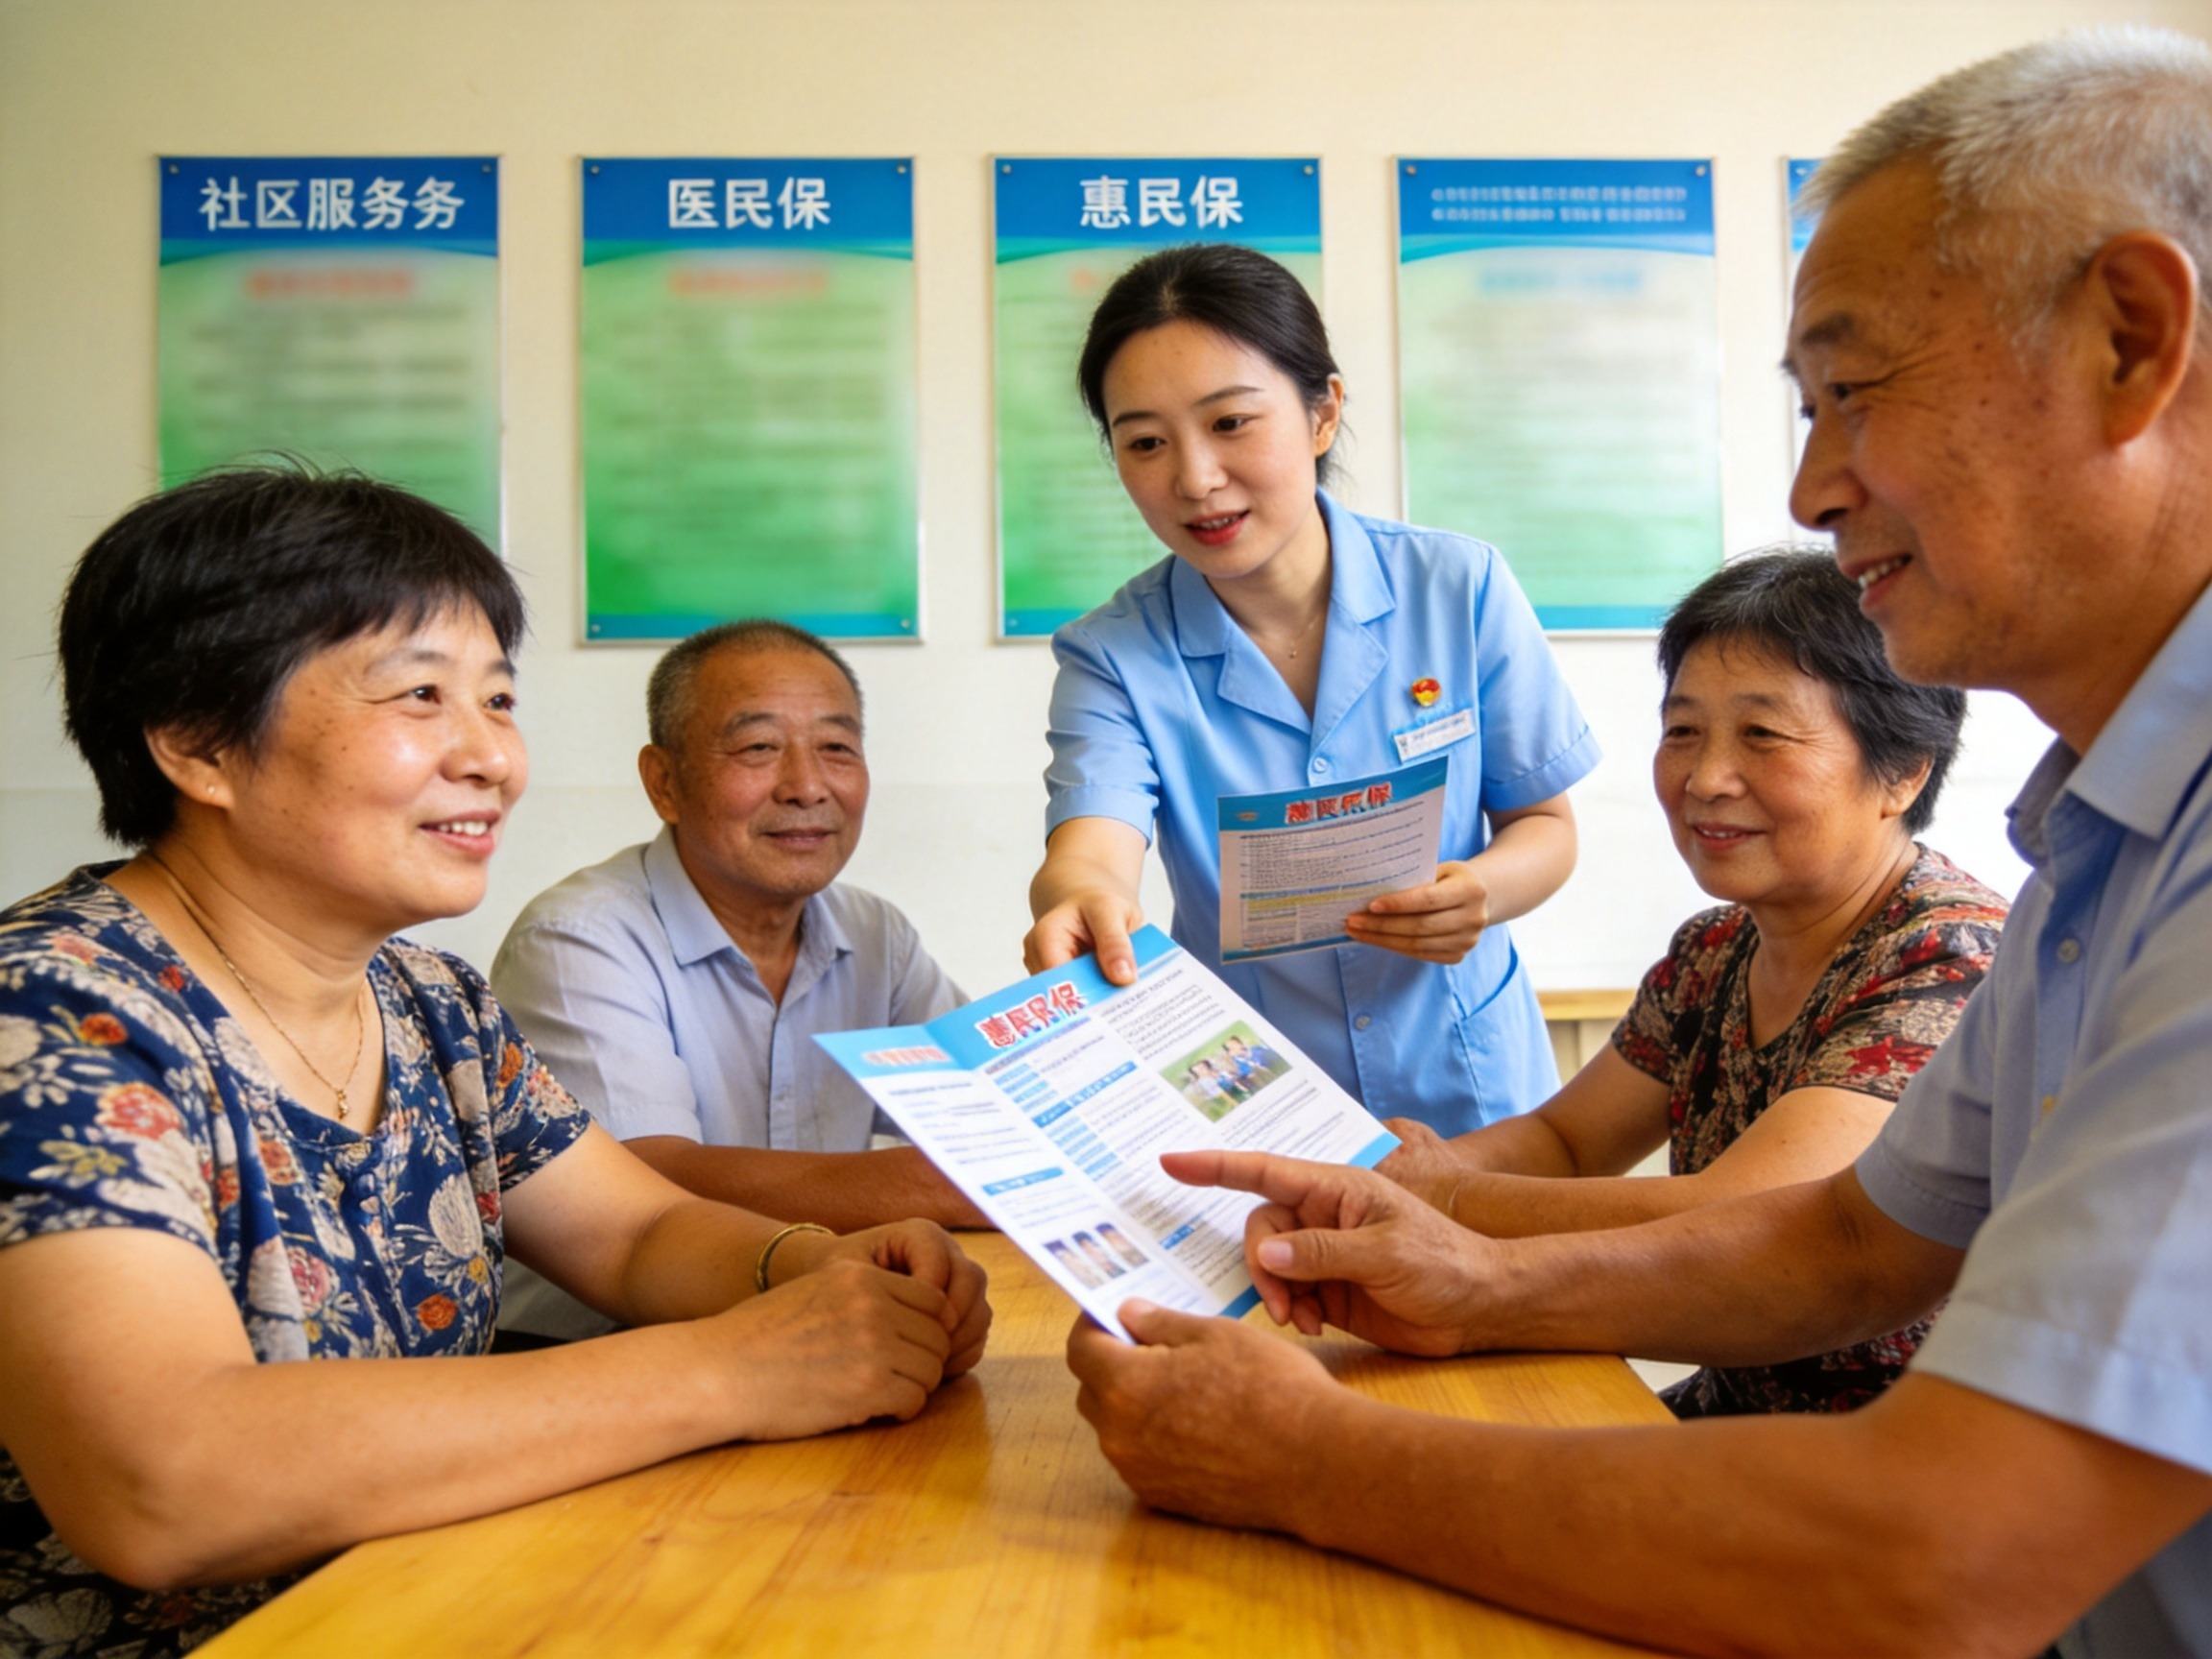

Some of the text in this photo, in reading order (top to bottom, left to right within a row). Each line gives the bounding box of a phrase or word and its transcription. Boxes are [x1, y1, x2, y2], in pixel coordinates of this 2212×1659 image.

[199, 177, 465, 230] 社区服务务
[668, 177, 831, 229] 医民保
[1079, 175, 1244, 228] 惠民保
